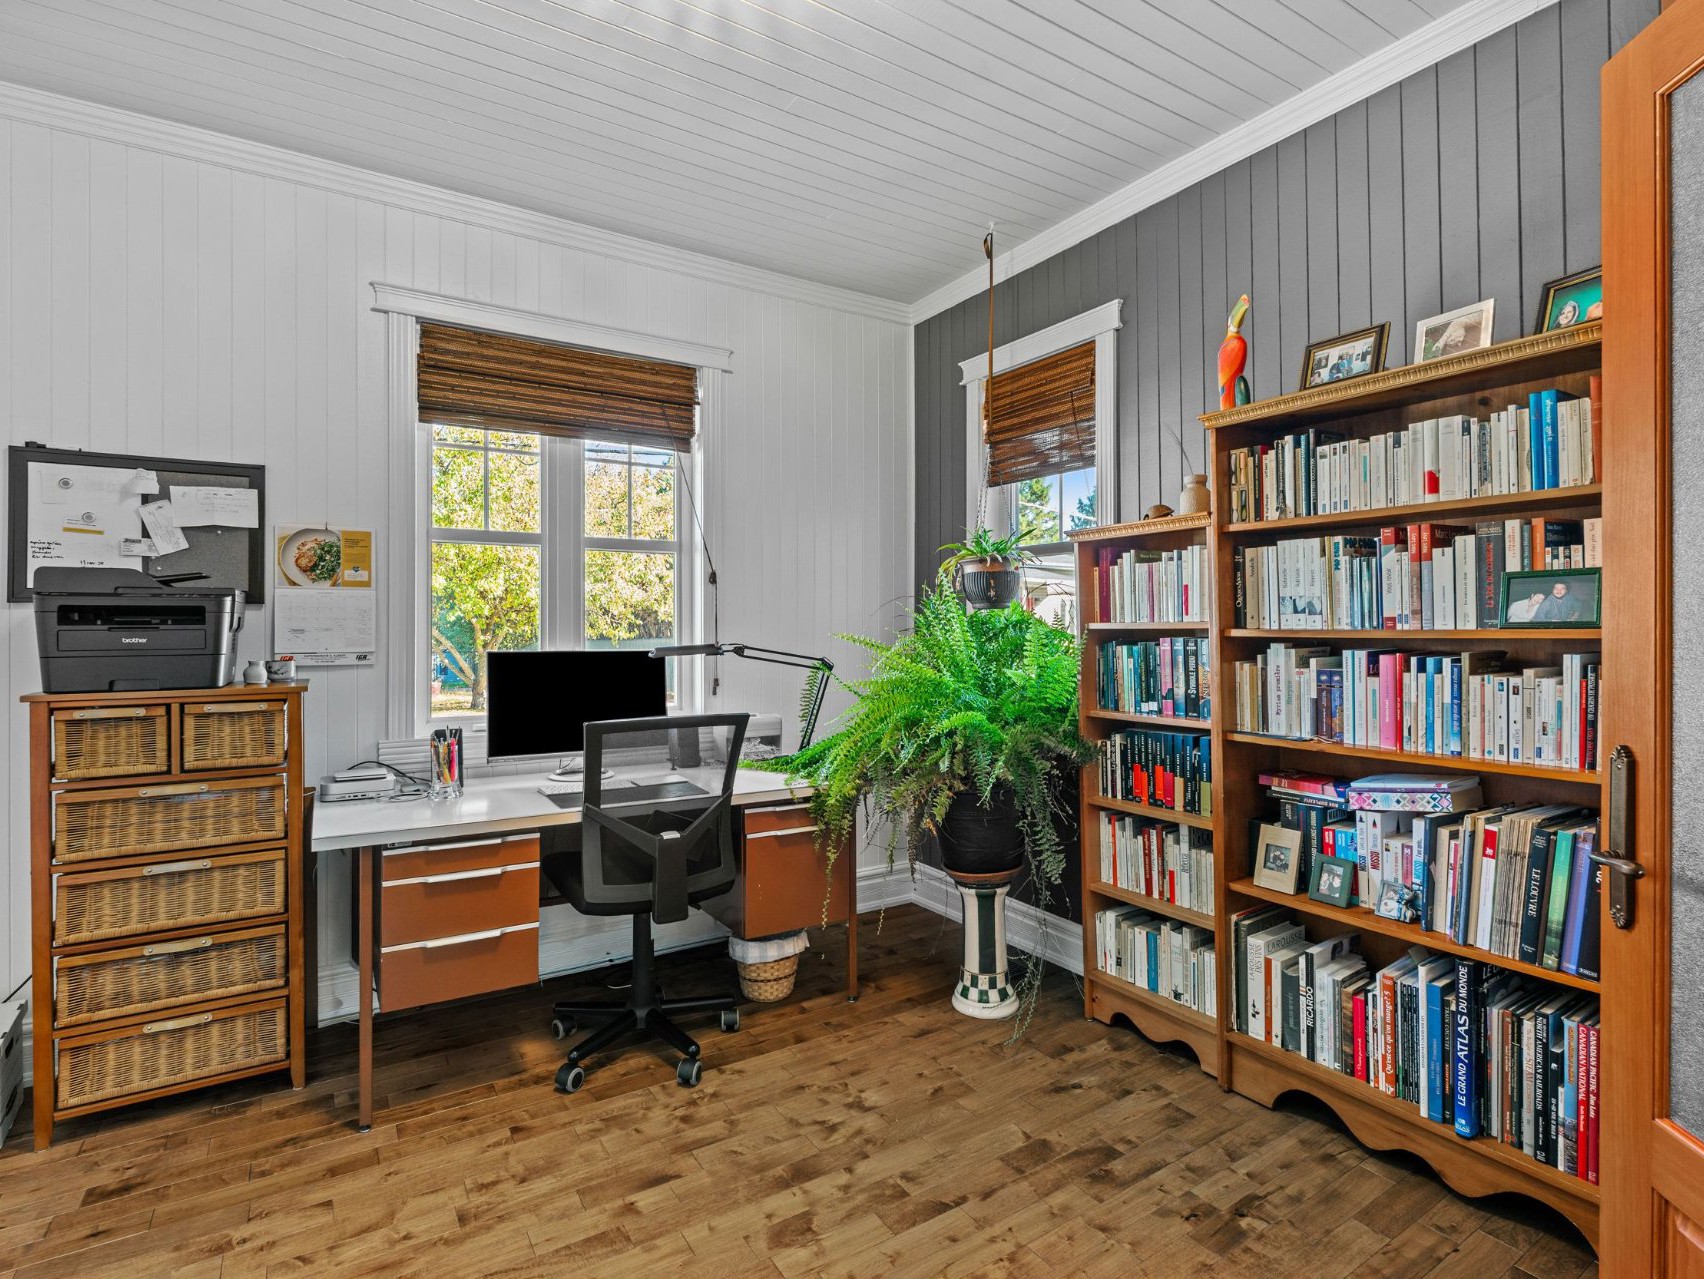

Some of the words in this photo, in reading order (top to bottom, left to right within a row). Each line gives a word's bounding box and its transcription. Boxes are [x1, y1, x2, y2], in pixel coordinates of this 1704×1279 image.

[1274, 664, 1282, 692] première
[1370, 851, 1380, 870] MUSSO
[1531, 869, 1540, 881] LE
[1528, 881, 1540, 917] LOUVRE
[1267, 930, 1302, 952] LAROUSSE
[1459, 966, 1468, 999] MONDE
[1306, 986, 1314, 1027] RICARDO
[1459, 999, 1468, 1013] DU
[1385, 1024, 1393, 1044] qu'on
[1457, 1014, 1469, 1064] ATLAS
[1579, 1027, 1587, 1064] CANADIAN
[1589, 1030, 1598, 1065] CANADIAN
[1458, 1063, 1466, 1095] GRAND
[1525, 1057, 1533, 1082] STEAM
[1579, 1064, 1587, 1101] NATIONAL
[1589, 1066, 1598, 1092] PACIFIC
[1458, 1095, 1466, 1107] LE
[1589, 1094, 1598, 1105] Jim
[1589, 1106, 1598, 1119] Lotz
